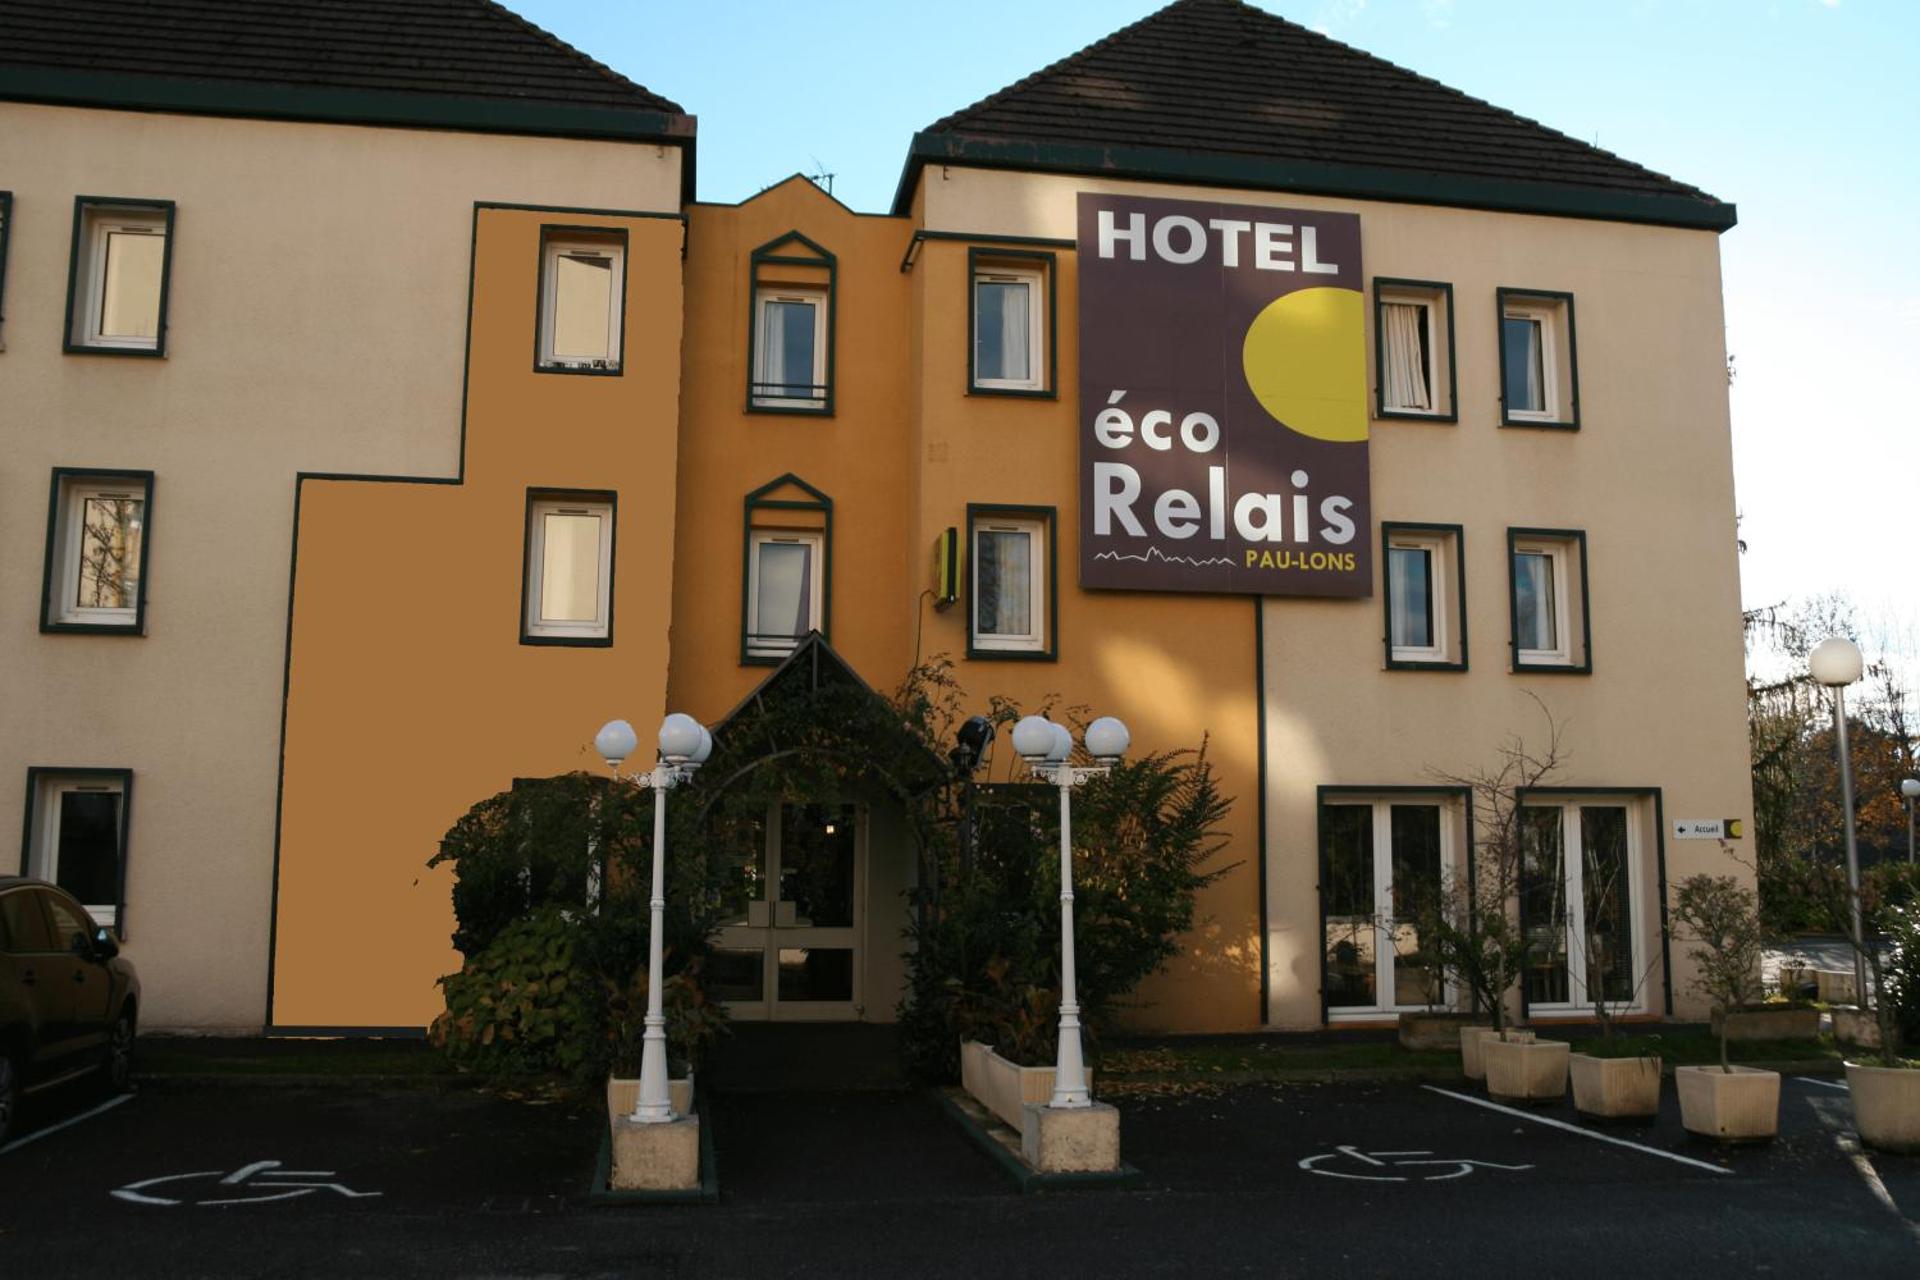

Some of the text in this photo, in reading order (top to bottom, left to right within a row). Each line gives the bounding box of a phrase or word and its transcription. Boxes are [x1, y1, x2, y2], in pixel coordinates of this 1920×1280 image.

[1097, 210, 1339, 275] HOTEL
[1094, 390, 1220, 453] éco
[1093, 461, 1356, 545] Relais
[1245, 550, 1356, 571] PAU-LONS
